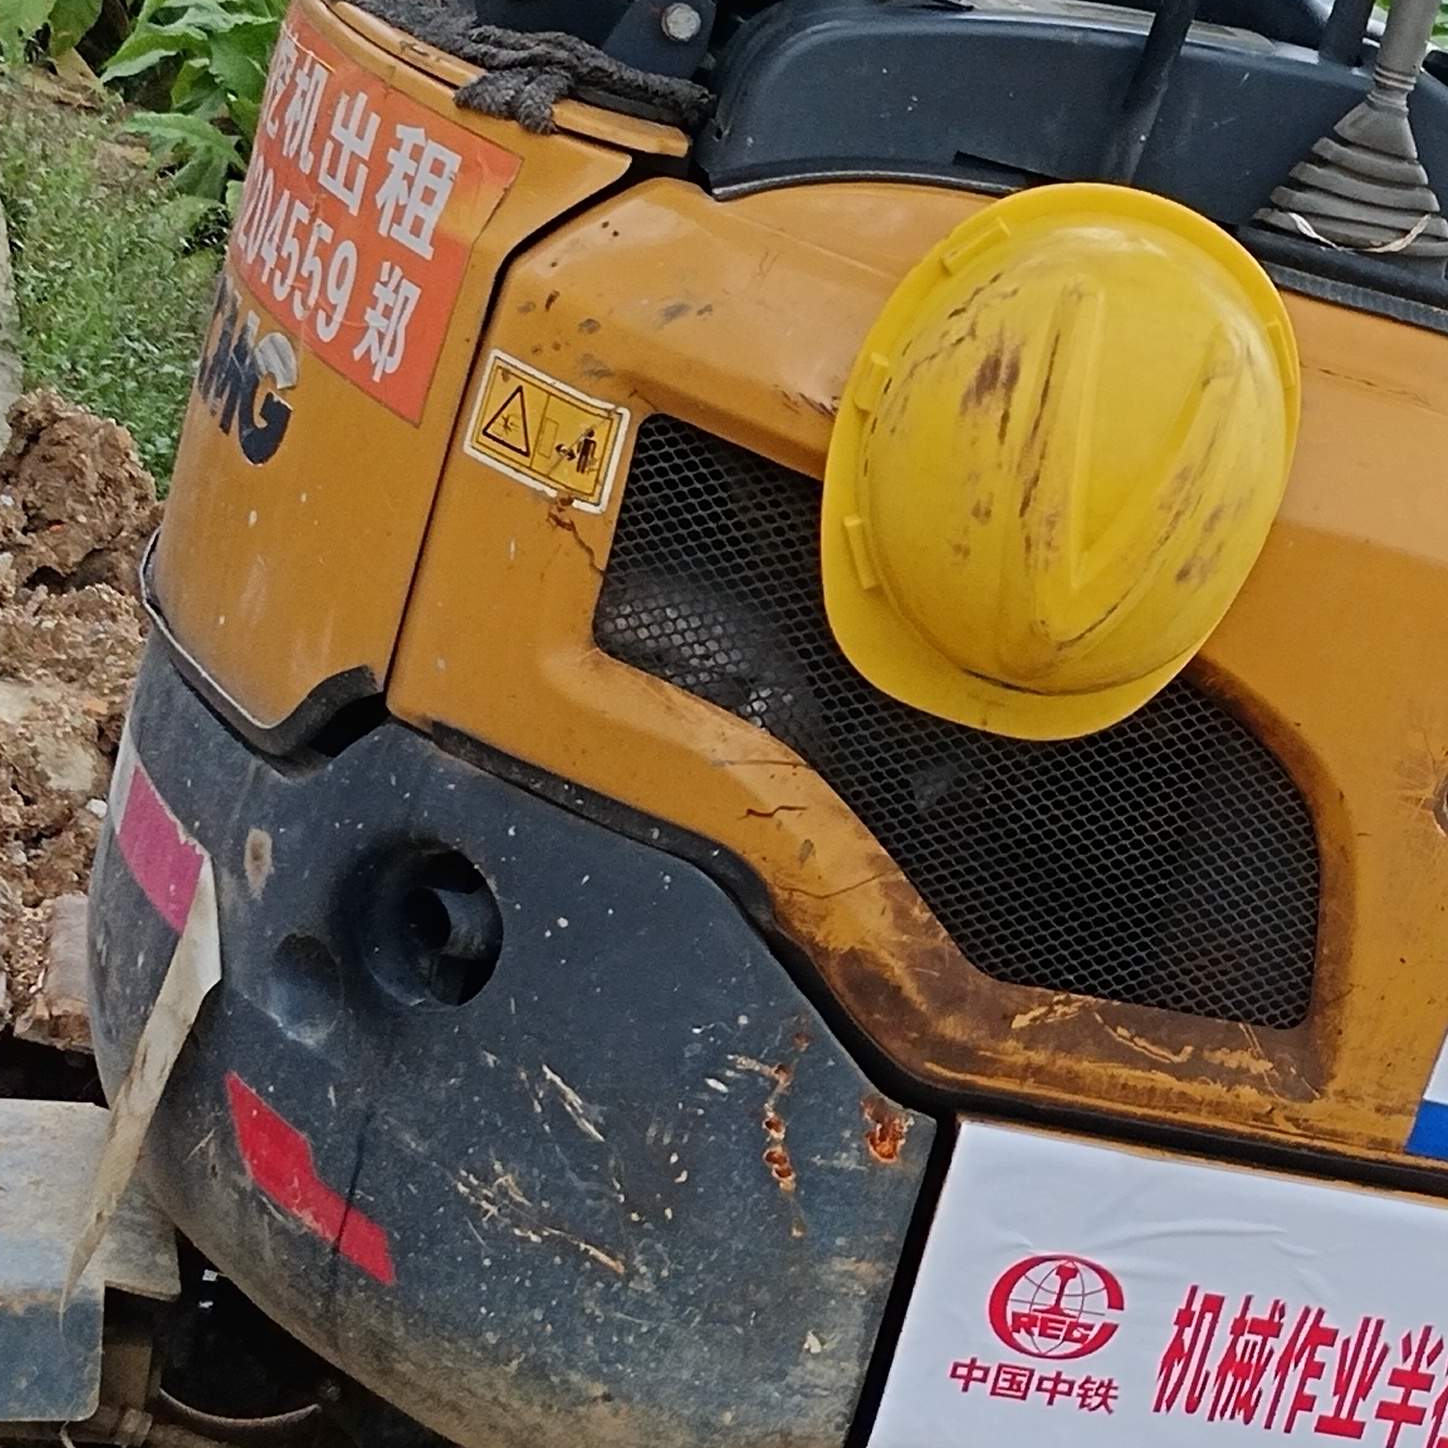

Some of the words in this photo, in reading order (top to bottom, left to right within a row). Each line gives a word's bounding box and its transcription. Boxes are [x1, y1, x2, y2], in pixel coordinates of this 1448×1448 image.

[352, 260, 422, 384] 郑
[949, 1356, 1120, 1415] 中国中铁
